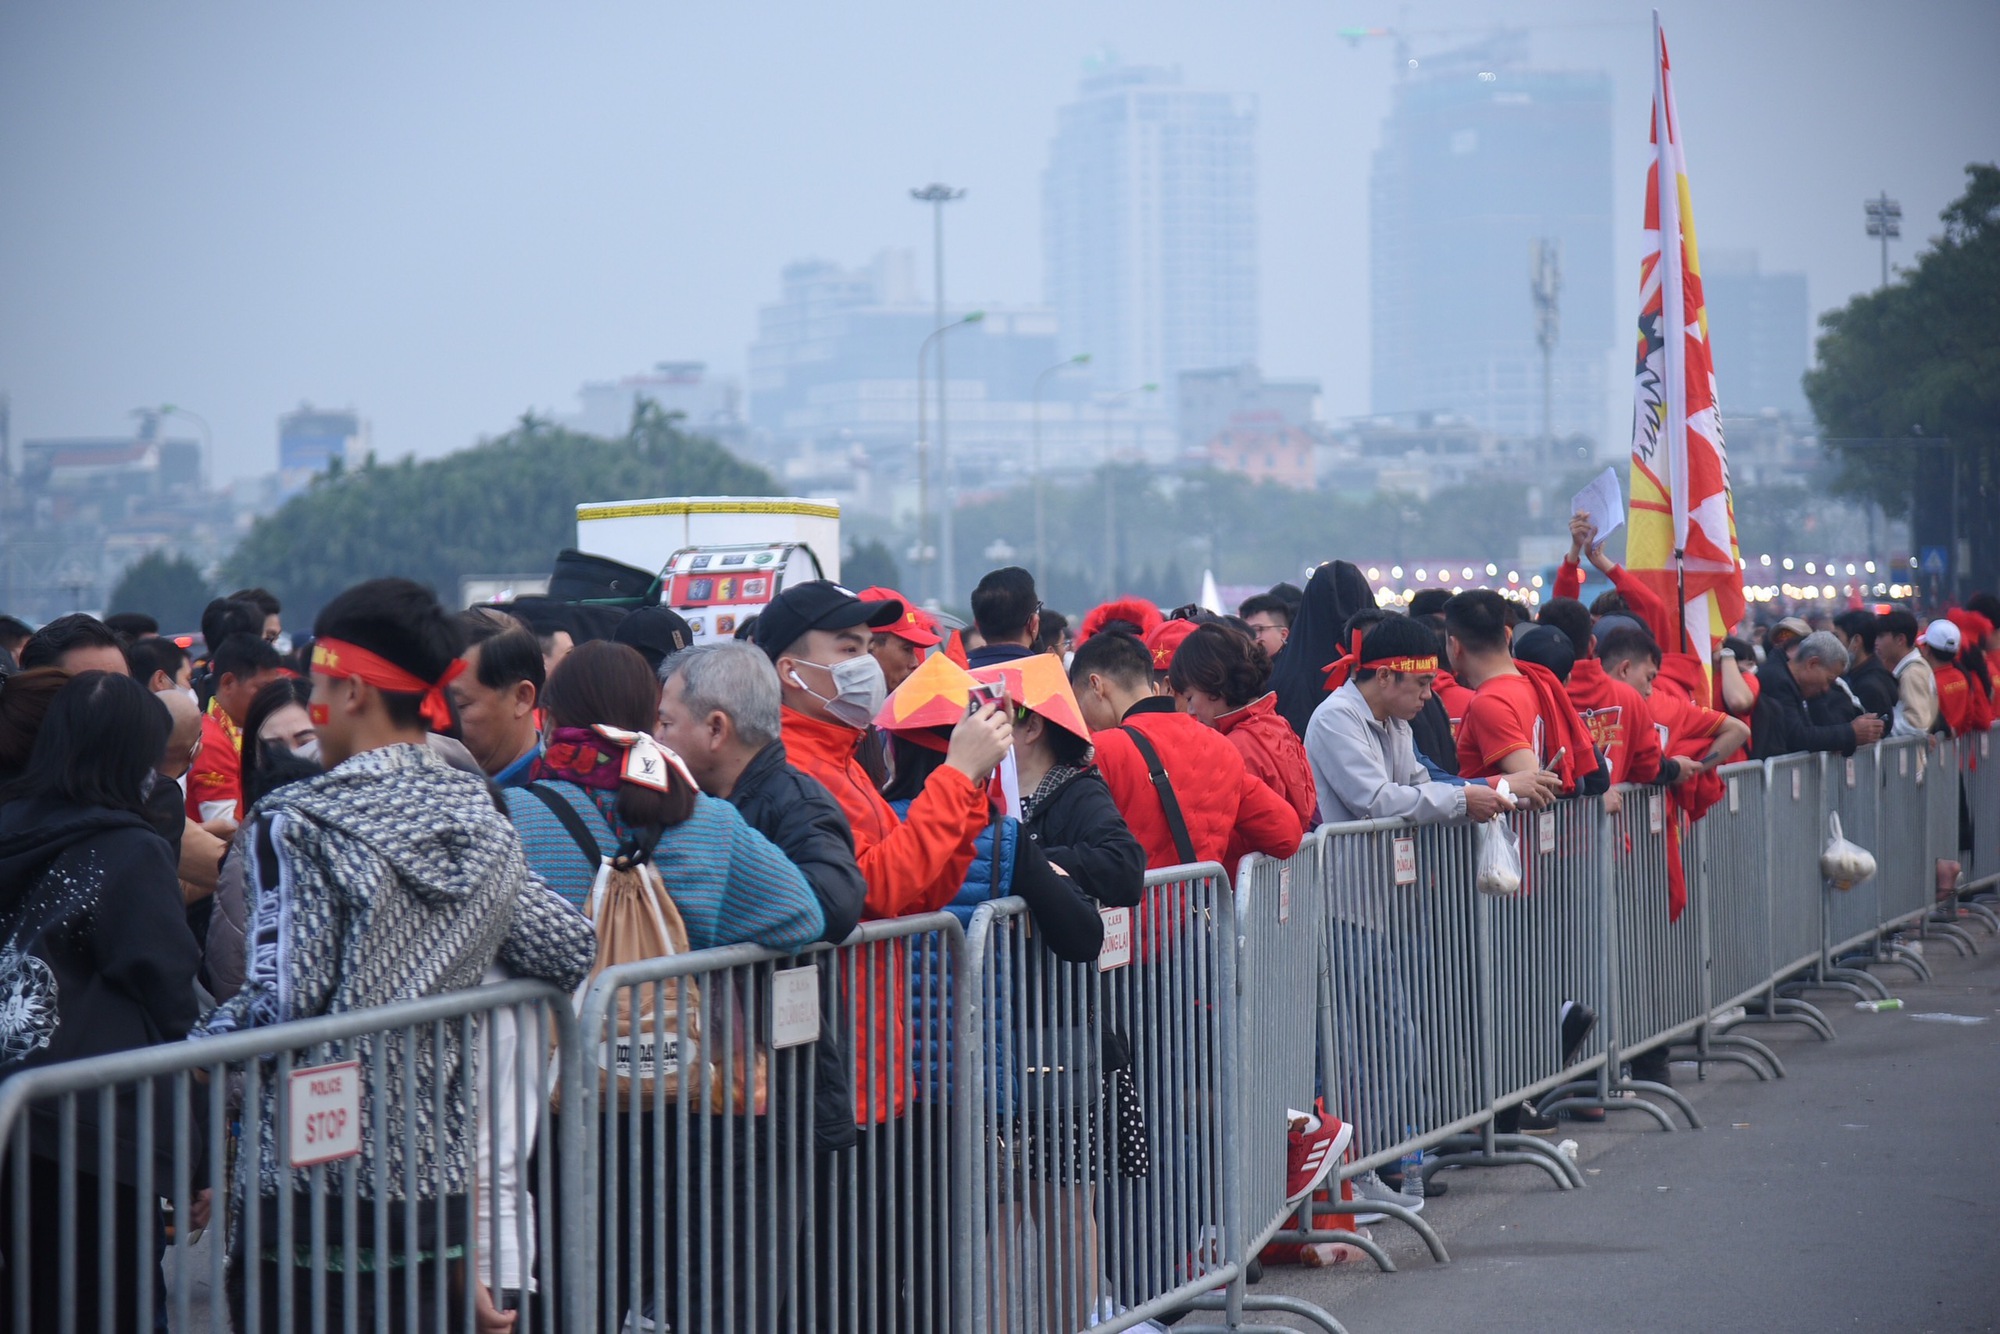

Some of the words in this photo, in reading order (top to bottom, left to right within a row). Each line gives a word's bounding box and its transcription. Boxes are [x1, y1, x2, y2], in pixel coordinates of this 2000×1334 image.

[1416, 659, 1431, 670] NAM
[257, 886, 281, 932] DIOR
[310, 1077, 342, 1095] POLICE
[305, 1108, 347, 1144] STOP
